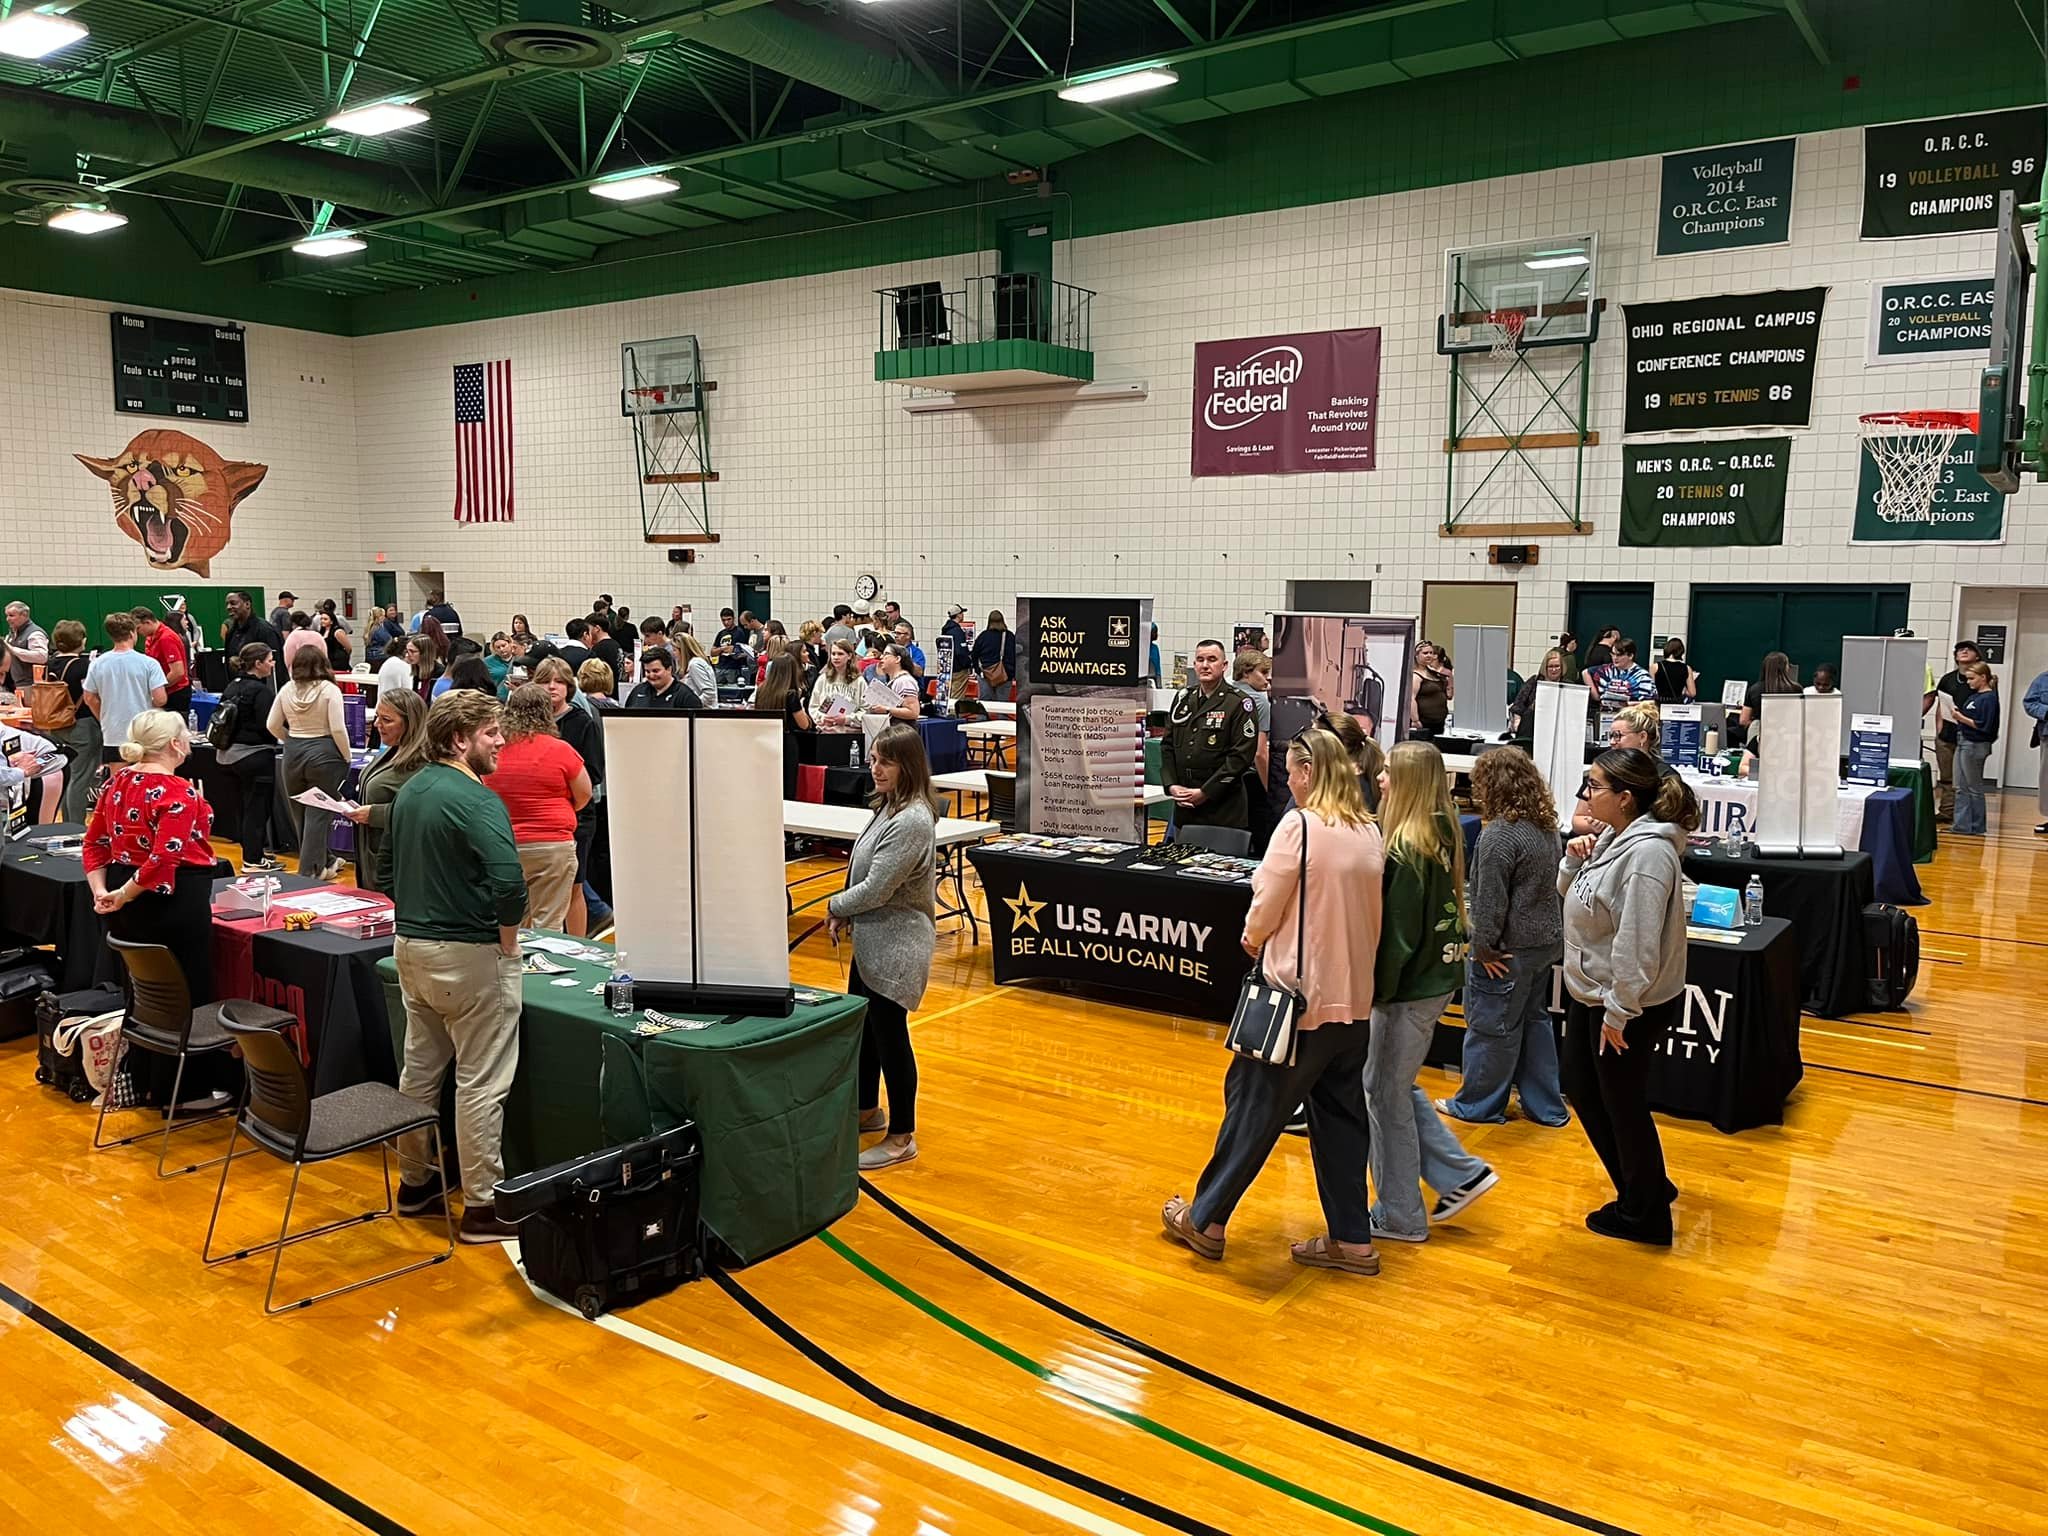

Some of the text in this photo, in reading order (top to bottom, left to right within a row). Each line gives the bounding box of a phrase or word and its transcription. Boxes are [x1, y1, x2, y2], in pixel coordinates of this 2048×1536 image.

[1692, 158, 1763, 180] Volleyball
[1879, 157, 2035, 188] 19 VOLLEYBALL 96
[1706, 179, 1745, 196] 2014
[1672, 196, 1778, 218] O.R.C.C. East
[1910, 194, 1994, 216] CHAMPIONS
[1682, 216, 1765, 235] Champions
[1885, 291, 1994, 311] O.R.C.C. EAS
[122, 315, 145, 328] Home
[1632, 311, 1816, 339] OHIO REGIONAL CAMPUS
[1888, 317, 1901, 326] 20
[1909, 312, 1981, 324] VOLLEYBALL
[215, 329, 241, 341] Guests
[1896, 325, 1992, 342] CHAMPIONS
[171, 356, 196, 367] period
[1637, 349, 1806, 373] CONFERENCE CHAMPIONS
[172, 370, 197, 381] player
[1213, 360, 1295, 388] Fairfield
[1212, 386, 1288, 415] Federal
[1331, 396, 1368, 407] Banking
[1644, 385, 1793, 409] 19 MEN'S TENNIS 86
[127, 400, 143, 408] won
[1307, 410, 1368, 420] That Revolves
[1311, 421, 1368, 432] Around YOU!
[1226, 445, 1251, 453] Savings
[1636, 458, 1672, 473] MEN'S
[1679, 457, 1713, 472] O.R.C.
[1729, 454, 1775, 470] O.R.C.C.
[1656, 483, 1745, 499] 20 TENNIS 01
[1953, 489, 1991, 503] East
[1662, 511, 1735, 527] CHAMPIONS
[1040, 616, 1067, 629] ASK
[1040, 631, 1085, 644] ABOUT
[1040, 646, 1078, 659] ARMY
[1040, 661, 1127, 676] ADVANTAGES
[1045, 705, 1123, 716] Guaranteed job choice
[1100, 716, 1114, 724] 150
[1045, 722, 1119, 733] Military Occupational
[1045, 730, 1106, 740] Specialties (MOS)
[1044, 747, 1060, 755] High
[1061, 748, 1084, 756] school
[1044, 755, 1064, 763] bonus
[1064, 773, 1090, 782] college
[1091, 774, 1121, 783] Student
[1044, 780, 1103, 790] Loan Repayment
[1044, 796, 1087, 806] 2-year initial
[1044, 805, 1104, 817] enlistment option
[1043, 820, 1059, 830] Duty
[1061, 822, 1093, 831] locations
[1094, 824, 1101, 832] in
[1056, 903, 1213, 952] U.S. ARMY
[1011, 937, 1213, 985] BE ALL YOU CAN BE.
